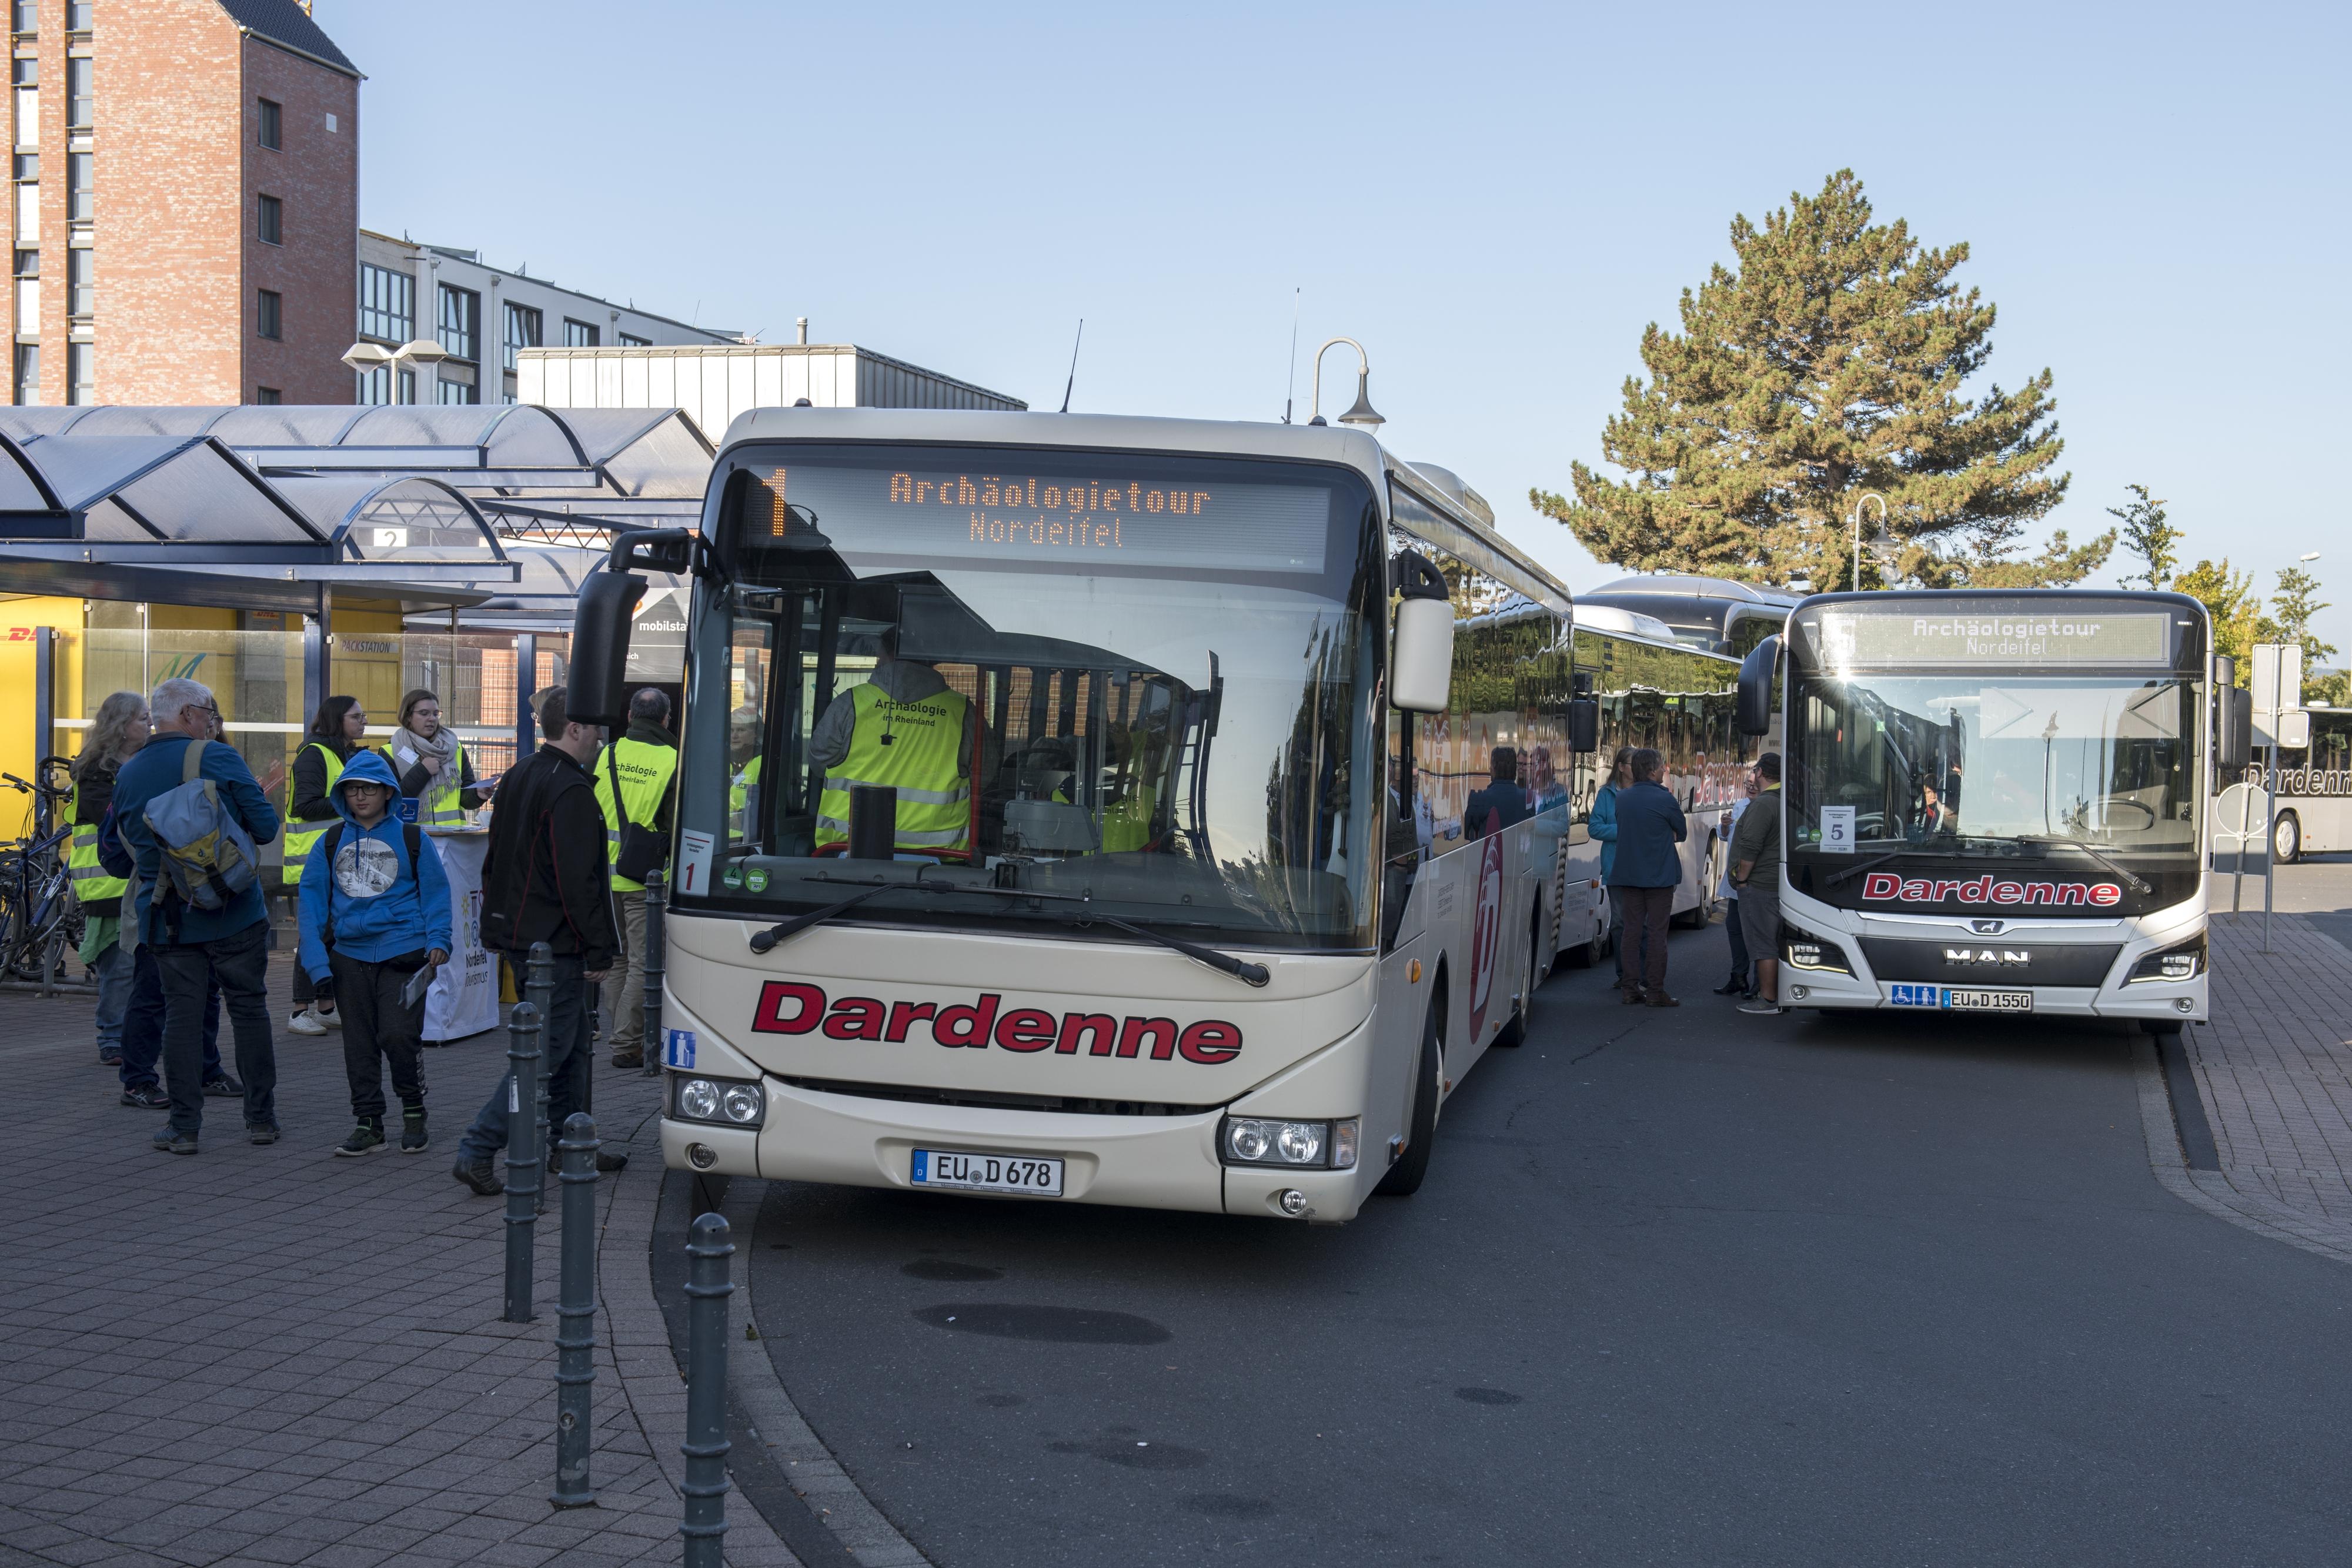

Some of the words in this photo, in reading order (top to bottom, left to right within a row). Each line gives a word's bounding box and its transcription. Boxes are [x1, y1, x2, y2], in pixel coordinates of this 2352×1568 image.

[762, 469, 786, 536] 1
[891, 473, 1211, 516] Archäologietour
[970, 512, 1122, 548] Nordeifel
[639, 621, 687, 631] mobilsta
[1913, 619, 2101, 638] Archäologietour
[342, 639, 390, 653] PACKSTATION
[1967, 638, 2047, 654] Nordeifel
[895, 716, 936, 727] Rheinland
[1831, 824, 1843, 840] 5
[686, 862, 695, 891] 1
[730, 868, 737, 878] 4
[1862, 872, 2122, 907] Dardenne
[1946, 949, 2030, 967] MAN
[1952, 993, 1970, 1006] EU
[1980, 994, 1989, 1007] D
[1993, 994, 2029, 1008] 1550
[751, 980, 1243, 1065] Dardenne
[937, 1156, 968, 1181] EU
[985, 1159, 1000, 1183] D
[1006, 1162, 1051, 1186] 678
